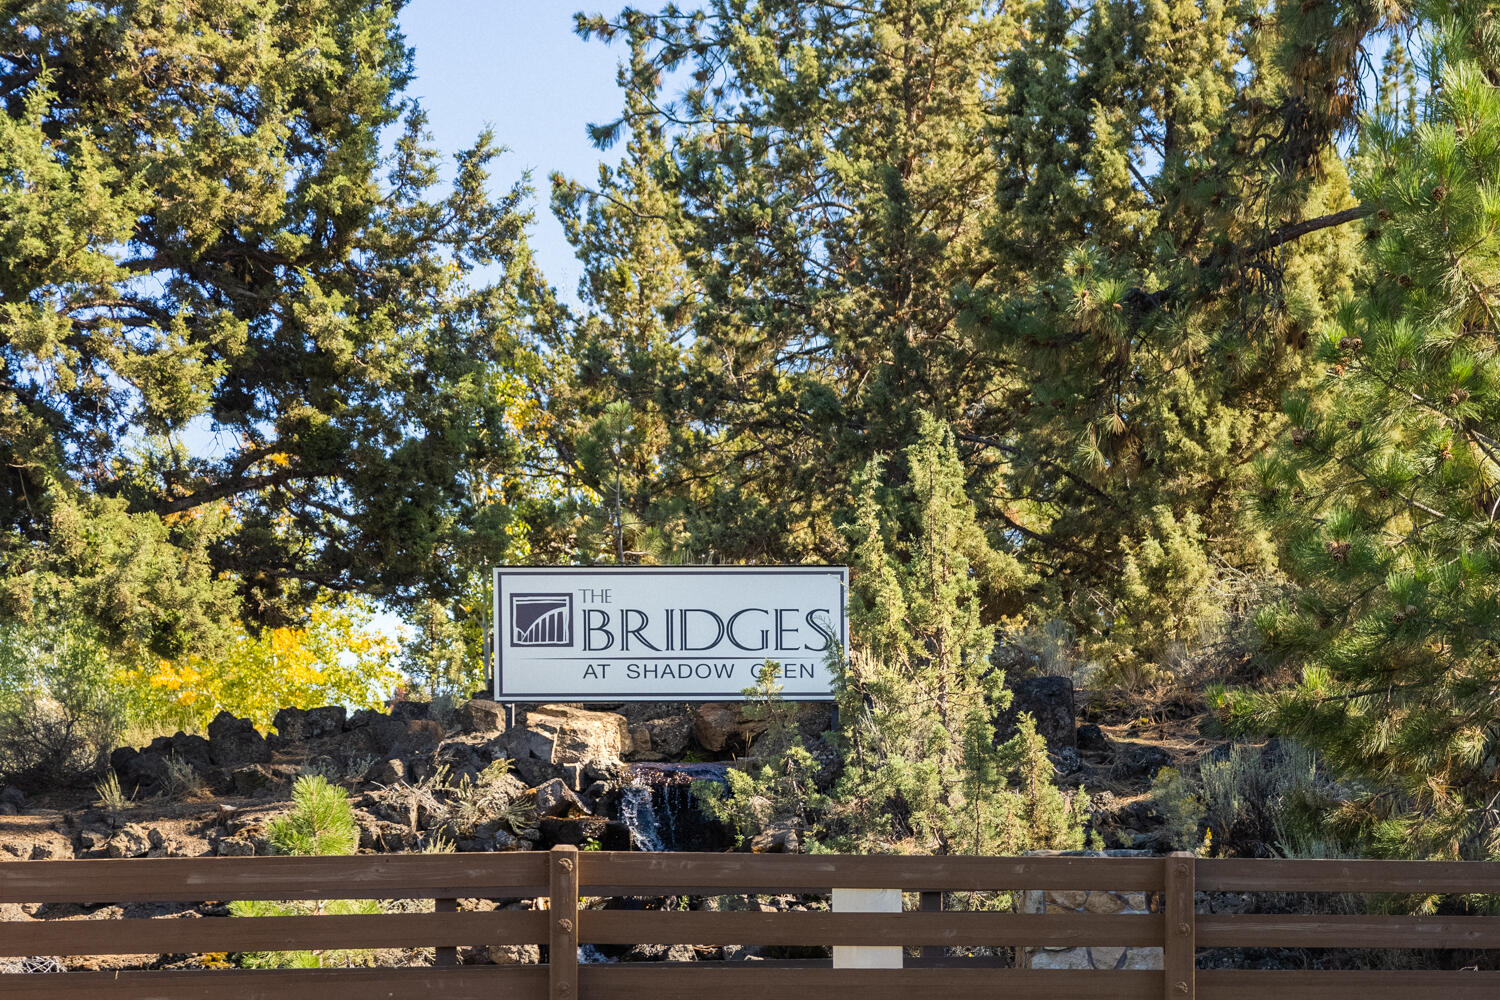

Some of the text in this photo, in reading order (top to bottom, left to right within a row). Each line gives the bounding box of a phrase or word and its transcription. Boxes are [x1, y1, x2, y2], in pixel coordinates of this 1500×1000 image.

[578, 588, 613, 604] THE
[581, 608, 833, 652] BRIDGES
[582, 663, 815, 679] AT SHADOW GEN
